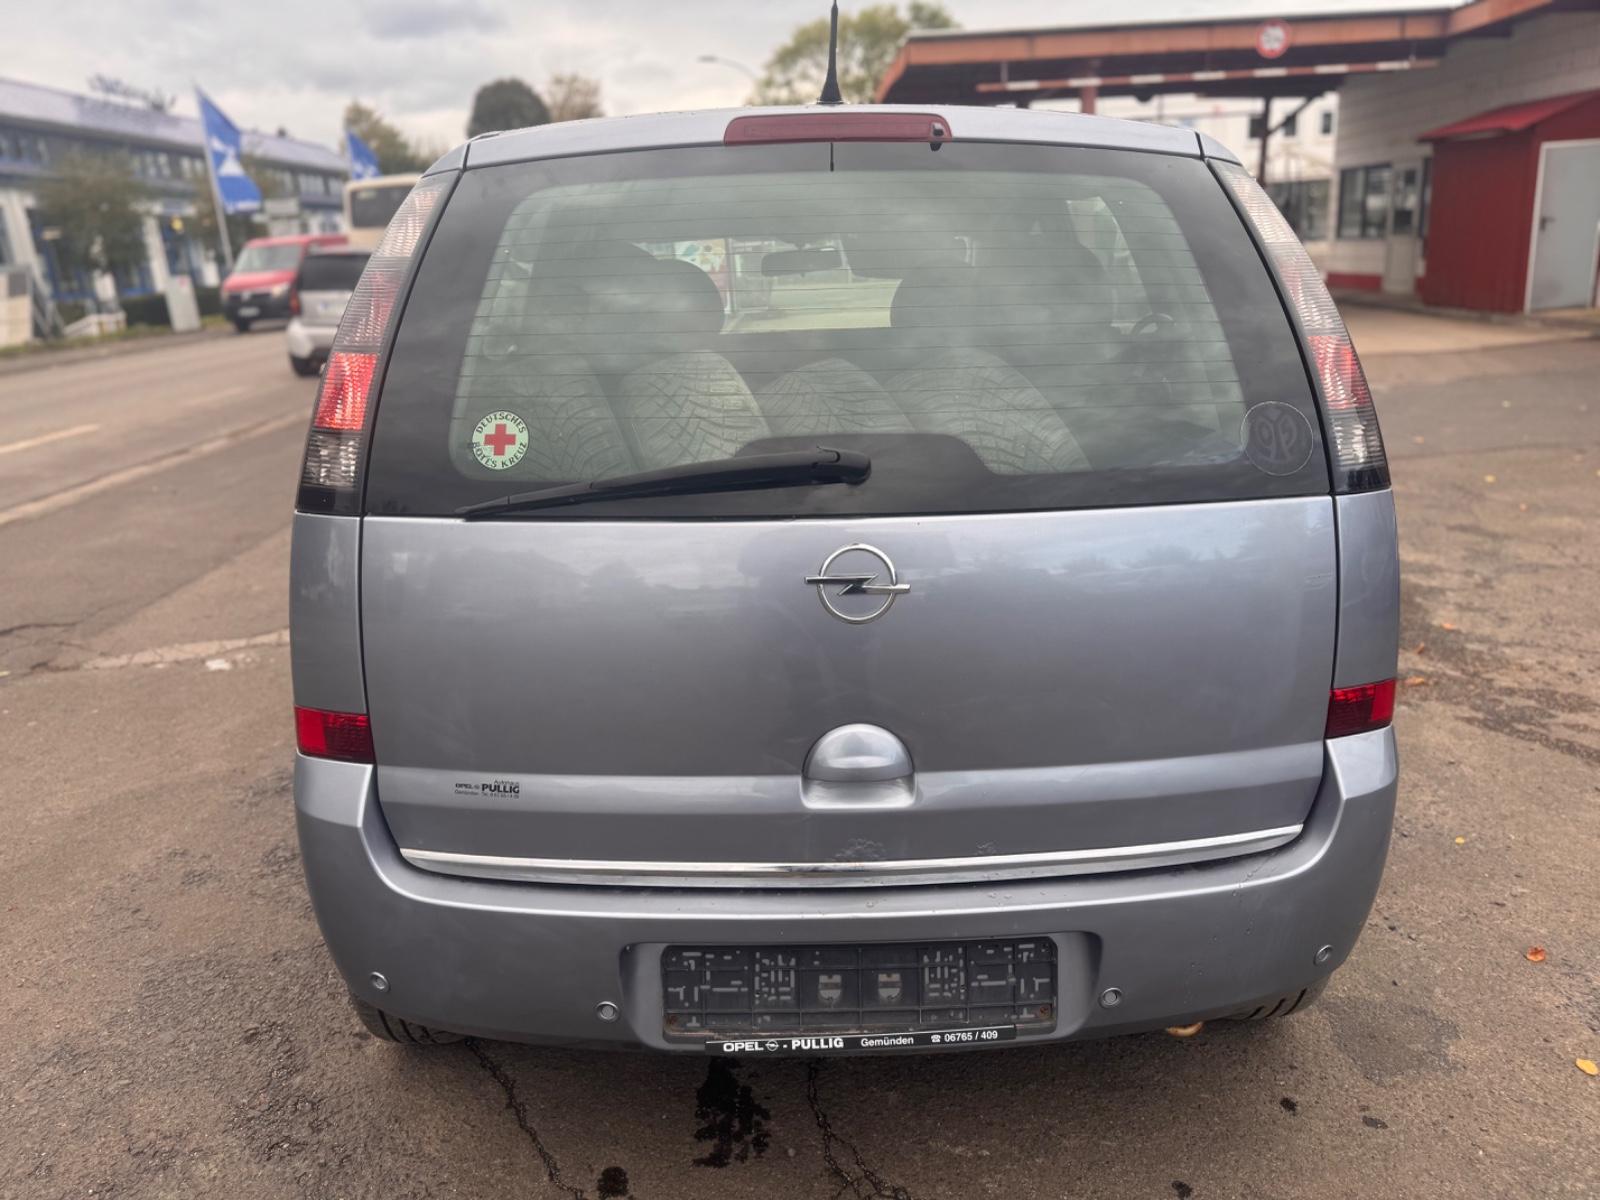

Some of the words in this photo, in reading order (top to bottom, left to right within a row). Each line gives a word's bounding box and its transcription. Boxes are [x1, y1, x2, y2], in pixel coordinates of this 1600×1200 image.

[475, 411, 527, 434] DEUTSCHES
[473, 441, 498, 468] ROTES
[501, 442, 527, 468] KREUZ
[482, 783, 519, 794] PULLIG
[723, 1041, 764, 1052] OPEL
[791, 1037, 844, 1050] PULLIG
[861, 1036, 914, 1047] Gemünden
[944, 1032, 973, 1042] 06765
[980, 1030, 998, 1040] 409
